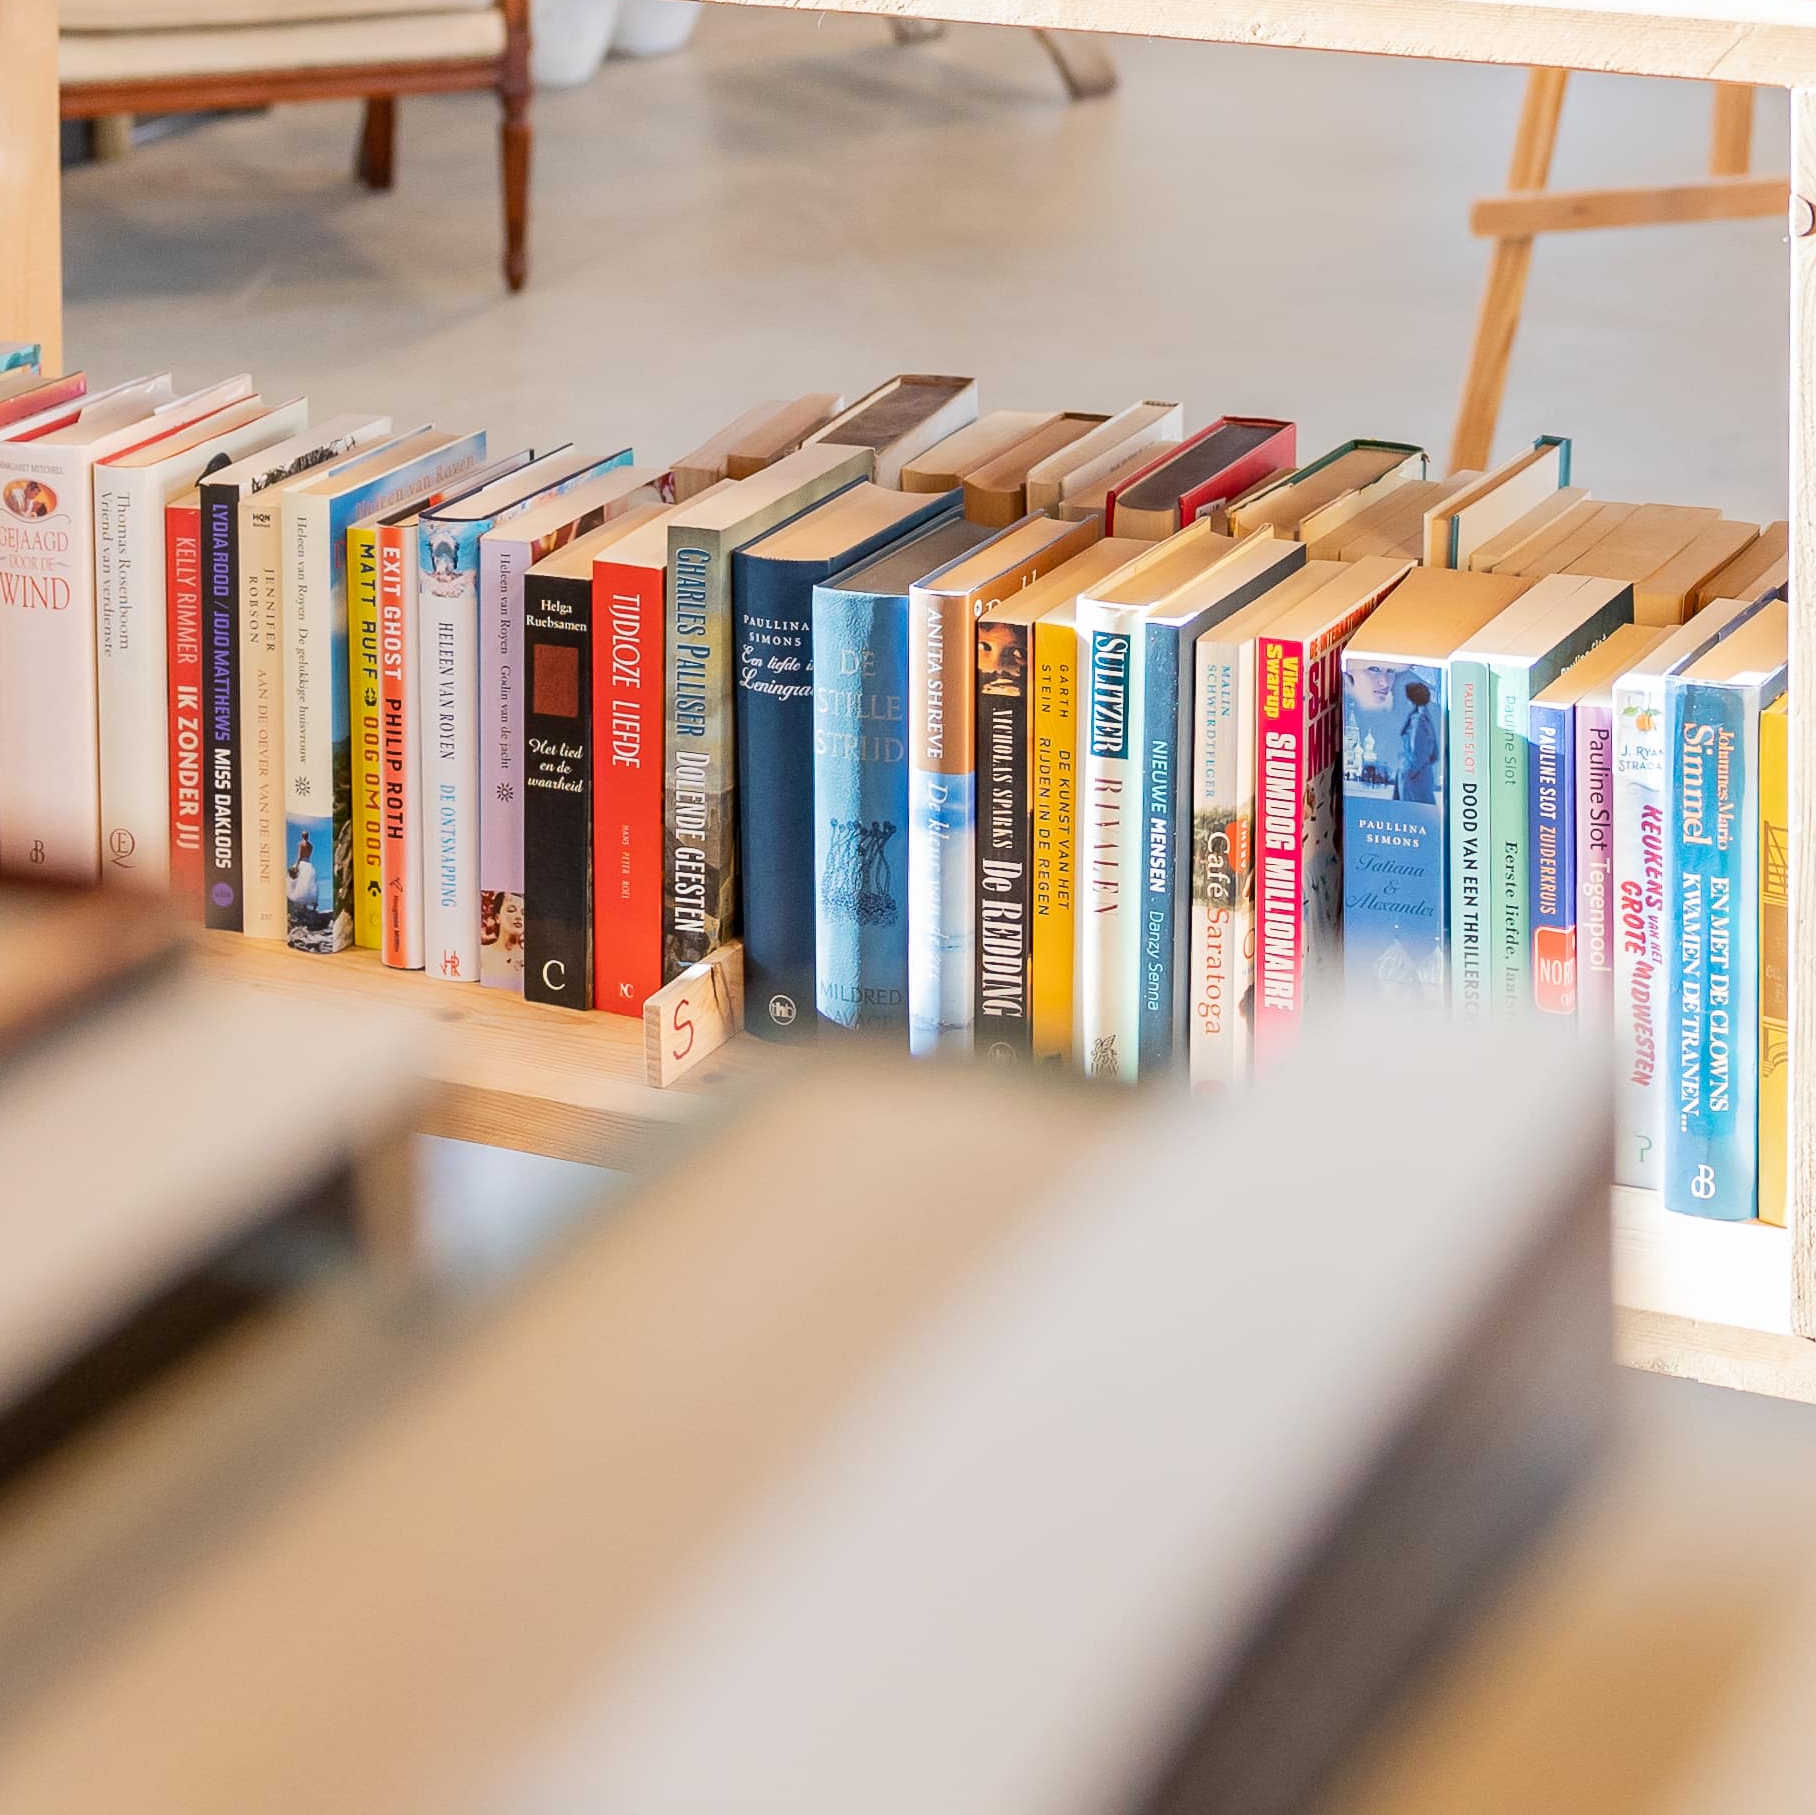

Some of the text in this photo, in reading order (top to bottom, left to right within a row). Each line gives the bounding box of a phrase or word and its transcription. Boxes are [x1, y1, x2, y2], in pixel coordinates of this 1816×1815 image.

[382, 546, 402, 681] EXIT GHOST
[611, 593, 640, 768] TIJDLOZE LIEFDE
[675, 547, 710, 737] CHARLES PALLISER
[1264, 643, 1284, 719] Swarup
[1282, 656, 1298, 710] Vikas
[1092, 635, 1129, 754] SULITZER
[385, 698, 403, 839] PHILIP ROTH
[992, 707, 1014, 850] NICHOLAS SPARKS
[673, 751, 711, 932] DOLENDE GEESTEN
[1264, 731, 1297, 1011] SLUMDOG MILLIONAIRE
[981, 858, 1023, 1019] De REDDING
